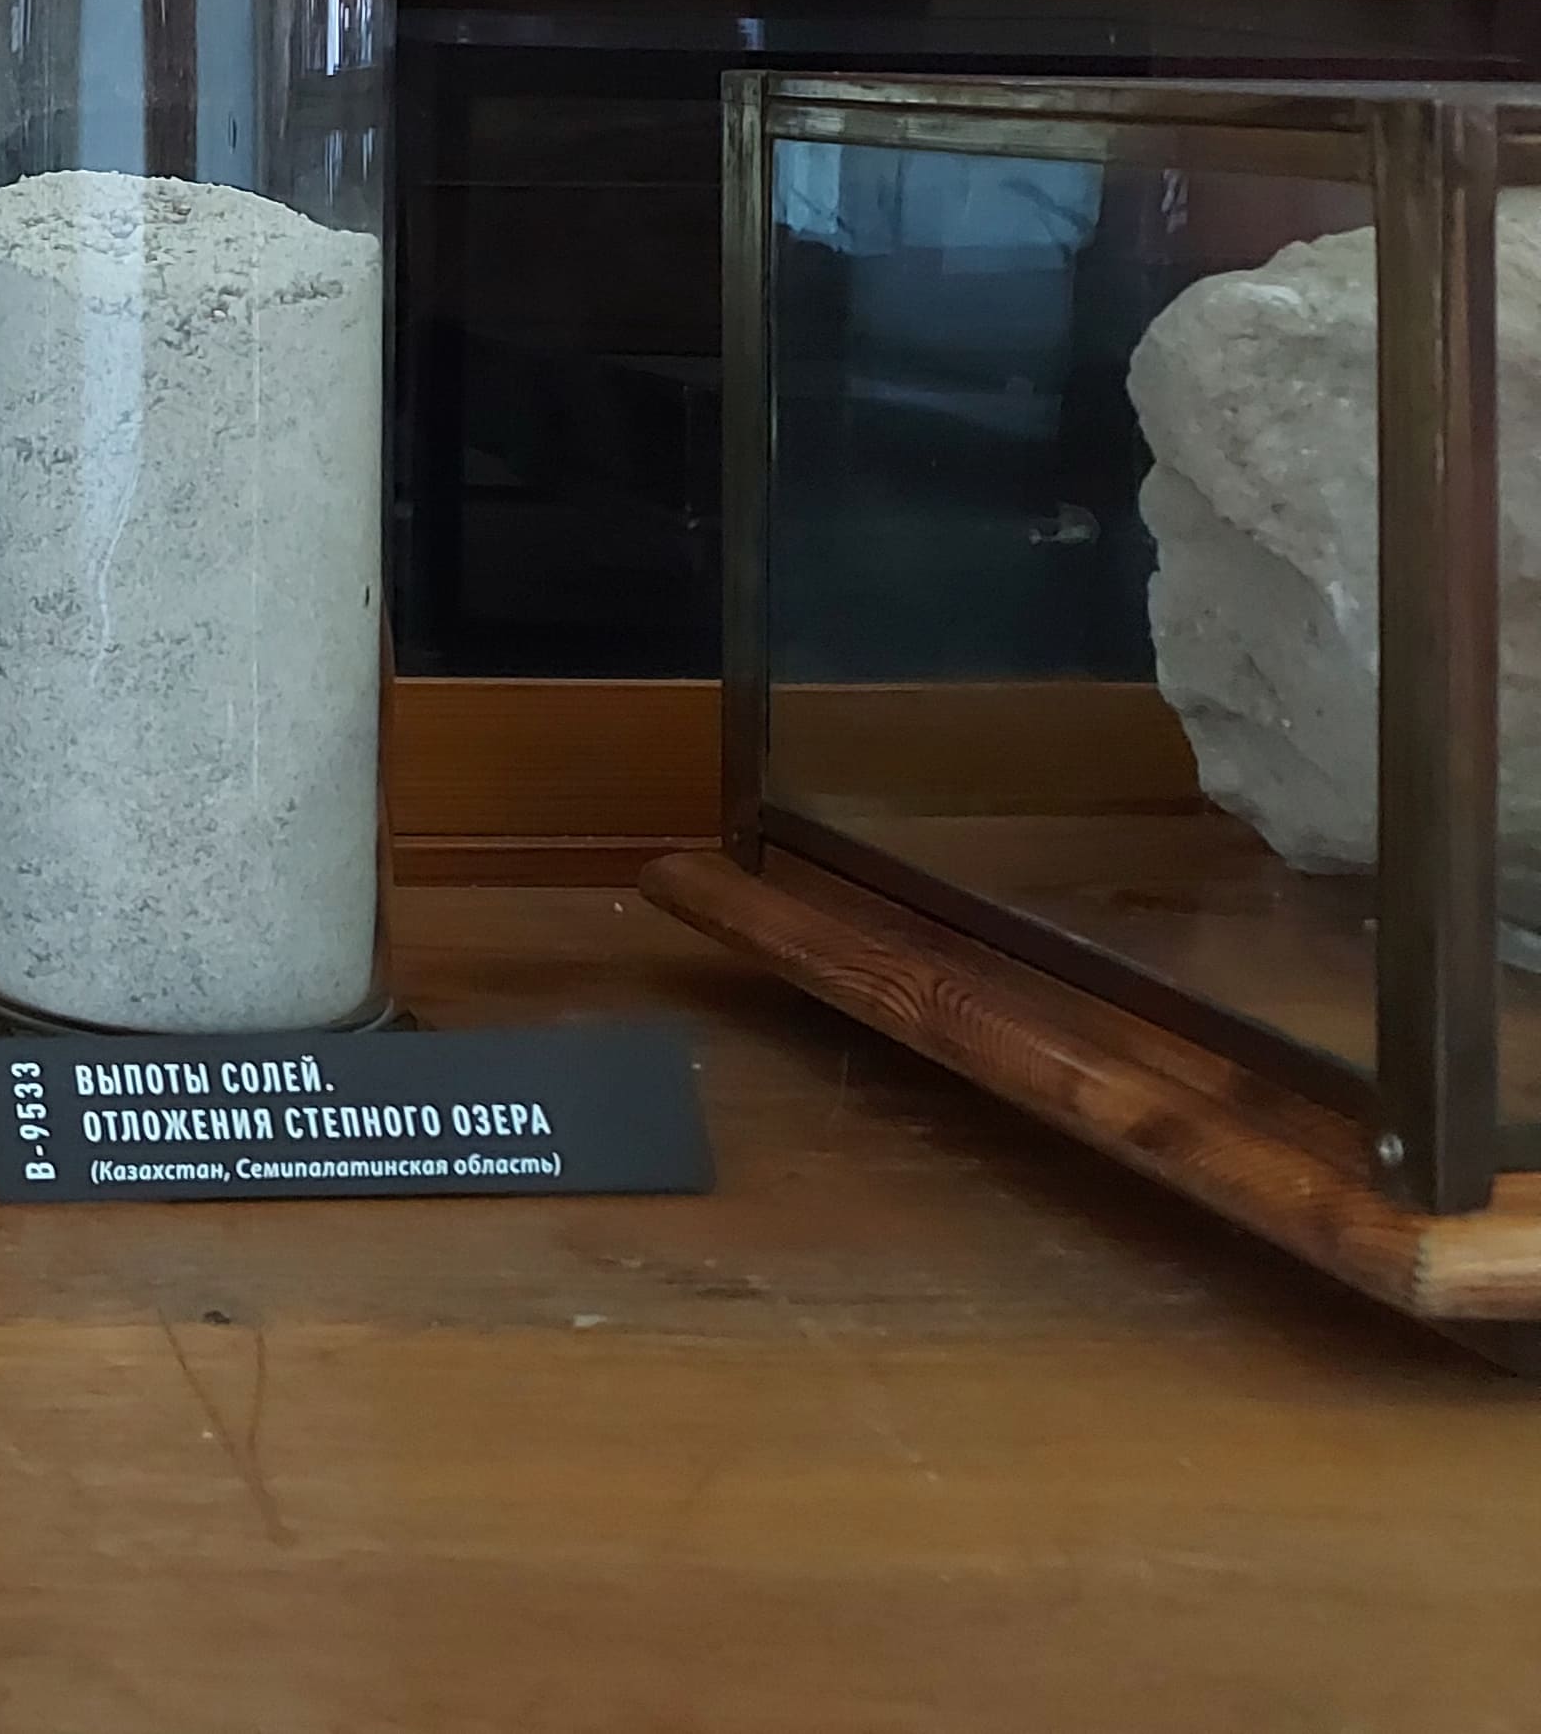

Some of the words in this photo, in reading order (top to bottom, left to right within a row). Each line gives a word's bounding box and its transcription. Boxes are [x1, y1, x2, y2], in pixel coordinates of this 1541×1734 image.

[75, 1063, 209, 1095] ВЫПОТЫ
[221, 1056, 334, 1093] СОЛЕЙ.
[11, 1063, 55, 1179] В-9533
[83, 1108, 273, 1142] ОТЛОЖЕНИЯ
[285, 1105, 440, 1138] СТЕПНОГО
[452, 1104, 551, 1136] ОЗЕРА
[91, 1160, 230, 1184] (Казахстан,
[236, 1158, 448, 1178] Семипалатинская
[454, 1153, 560, 1176] область)
